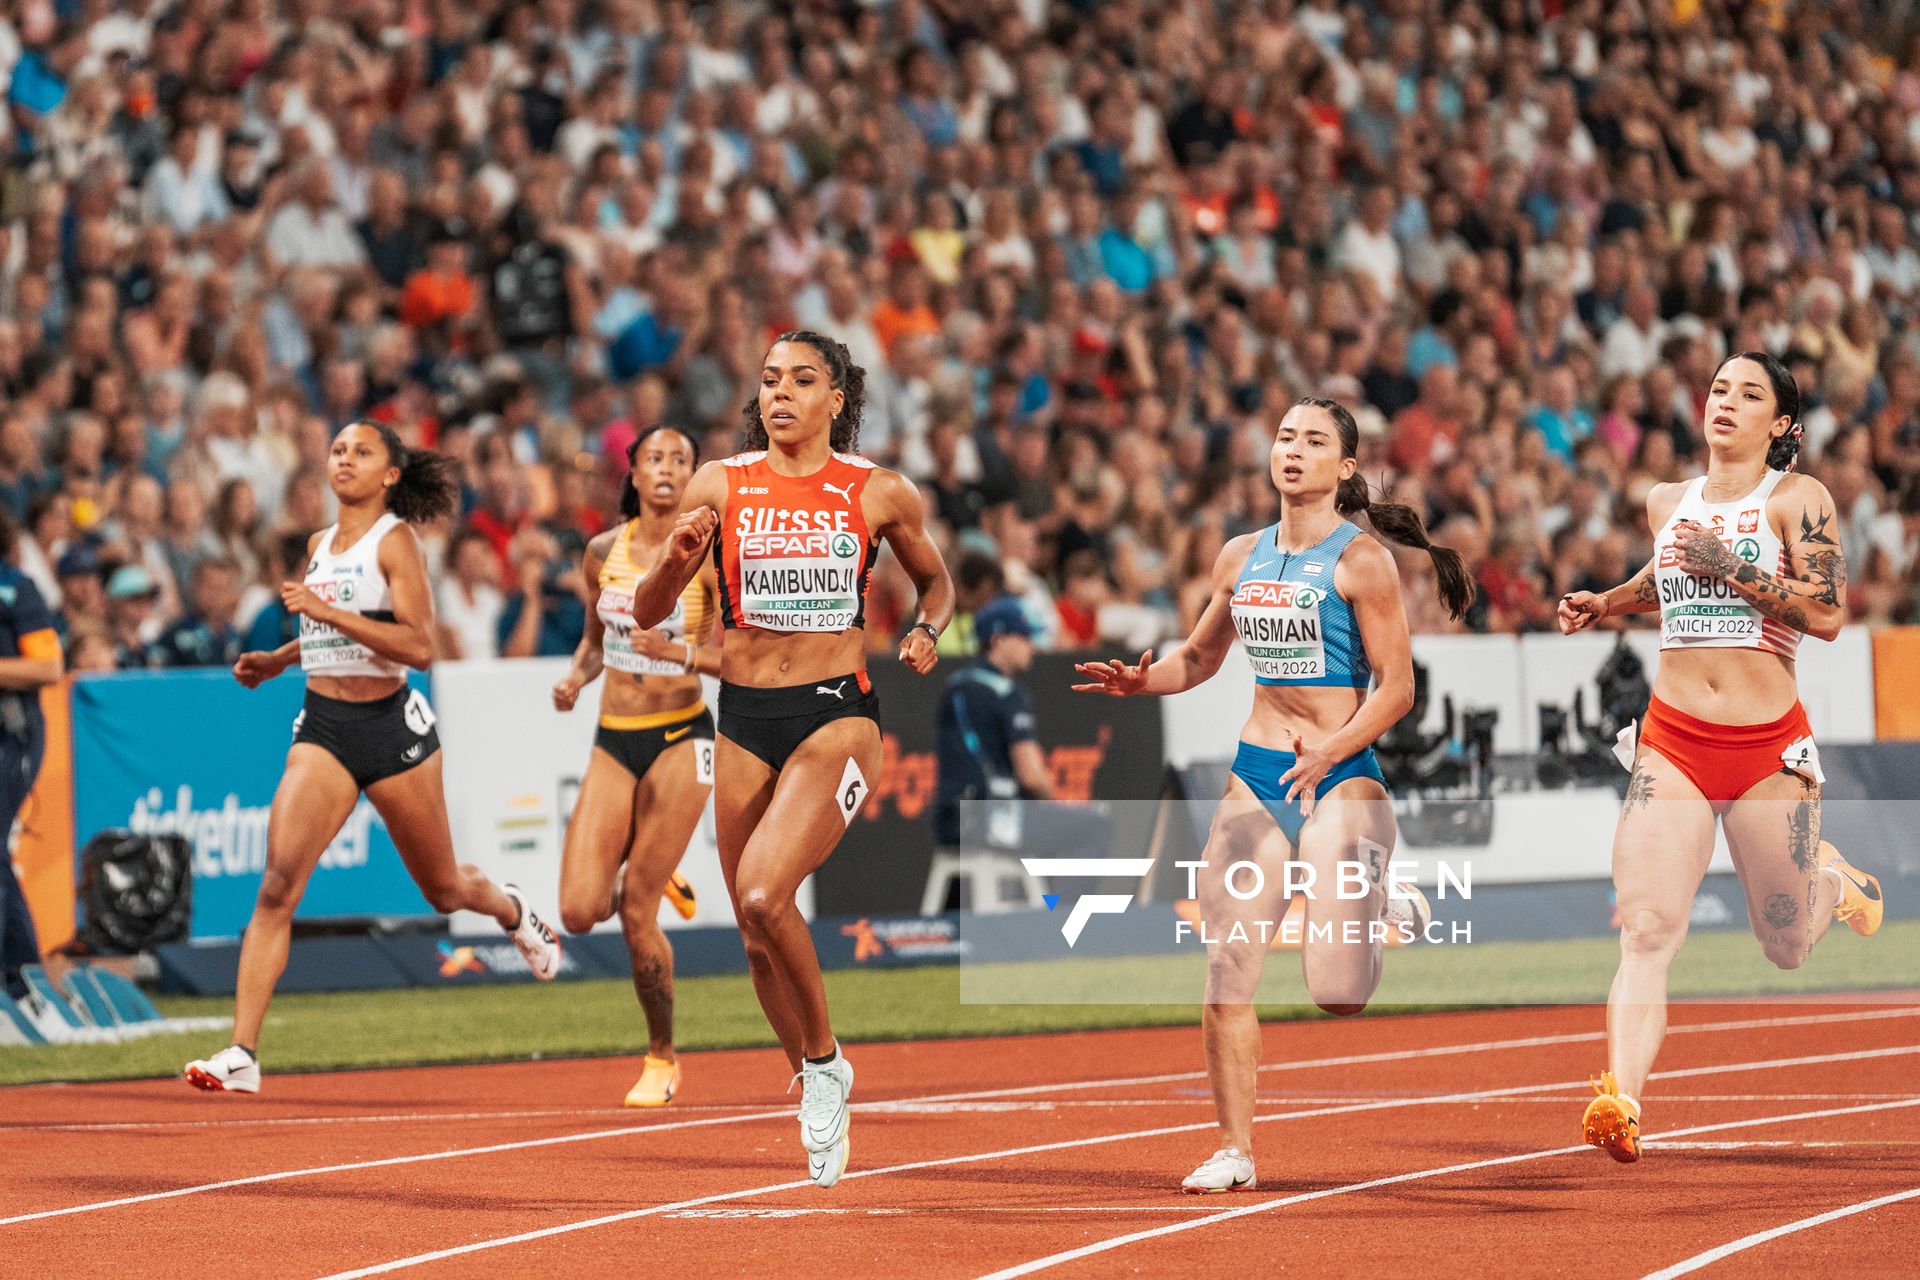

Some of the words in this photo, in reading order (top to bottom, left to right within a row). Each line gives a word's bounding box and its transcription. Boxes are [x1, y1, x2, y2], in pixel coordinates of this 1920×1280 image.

[750, 487, 769, 495] UBS
[745, 536, 829, 556] SPAR
[744, 568, 854, 595] KAMBUNDJI
[1233, 585, 1294, 604] SPAR
[775, 600, 798, 609] RUN
[1679, 606, 1698, 615] RUN
[750, 612, 812, 627] MUNICH
[817, 612, 854, 627] 2022
[1233, 615, 1318, 642] VAISMAN
[1717, 619, 1755, 634] 2022
[302, 650, 331, 665] UNICH
[334, 647, 363, 661] 2022
[1254, 647, 1268, 657] RUN
[1281, 660, 1318, 675] 2022
[410, 701, 427, 725] 7
[703, 748, 712, 776] 8
[845, 780, 862, 812] 6
[1370, 849, 1381, 884] 5
